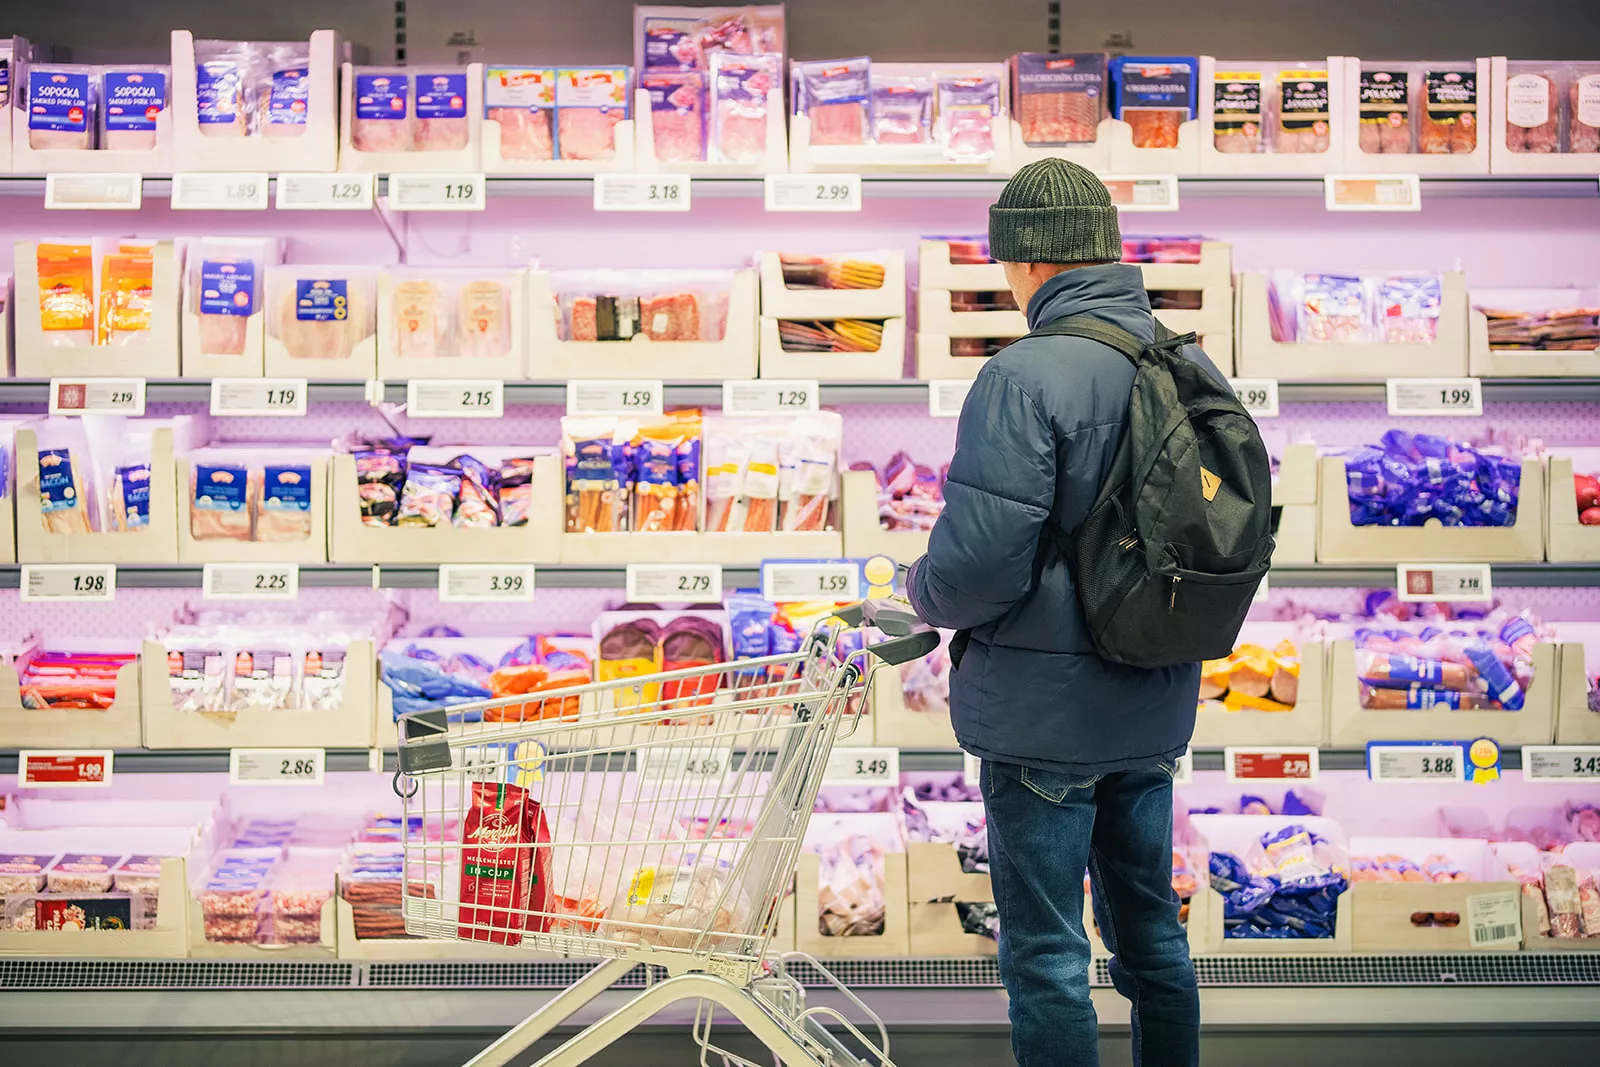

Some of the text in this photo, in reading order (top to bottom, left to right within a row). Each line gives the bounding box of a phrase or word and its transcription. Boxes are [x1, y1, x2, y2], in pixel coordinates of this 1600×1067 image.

[38, 86, 80, 98] SOPOCKA
[114, 86, 156, 98] SOPOCKA
[226, 184, 256, 198] 1.89
[331, 184, 361, 198] 1.29
[445, 184, 473, 198] 1.19
[649, 185, 678, 199] 3.18
[816, 185, 848, 199] 2.99
[112, 392, 132, 403] 2.19
[267, 389, 294, 404] 1.19
[462, 391, 492, 405] 2.15
[622, 391, 650, 405] 1.59
[778, 391, 807, 405] 1.29
[1440, 389, 1470, 404] 1.99
[73, 576, 103, 591] 1.98
[255, 575, 286, 589] 2.25
[490, 576, 522, 590] 3.99
[678, 576, 709, 590] 2.79
[818, 576, 847, 590] 1.59
[1460, 578, 1479, 588] 2.18
[78, 763, 101, 777] 1.99
[281, 759, 314, 775] 2.86
[856, 759, 887, 774] 3.49
[1422, 757, 1453, 773] 3.88
[467, 856, 515, 865] MELLEMRSTET
[470, 867, 510, 878] IN-CUP
